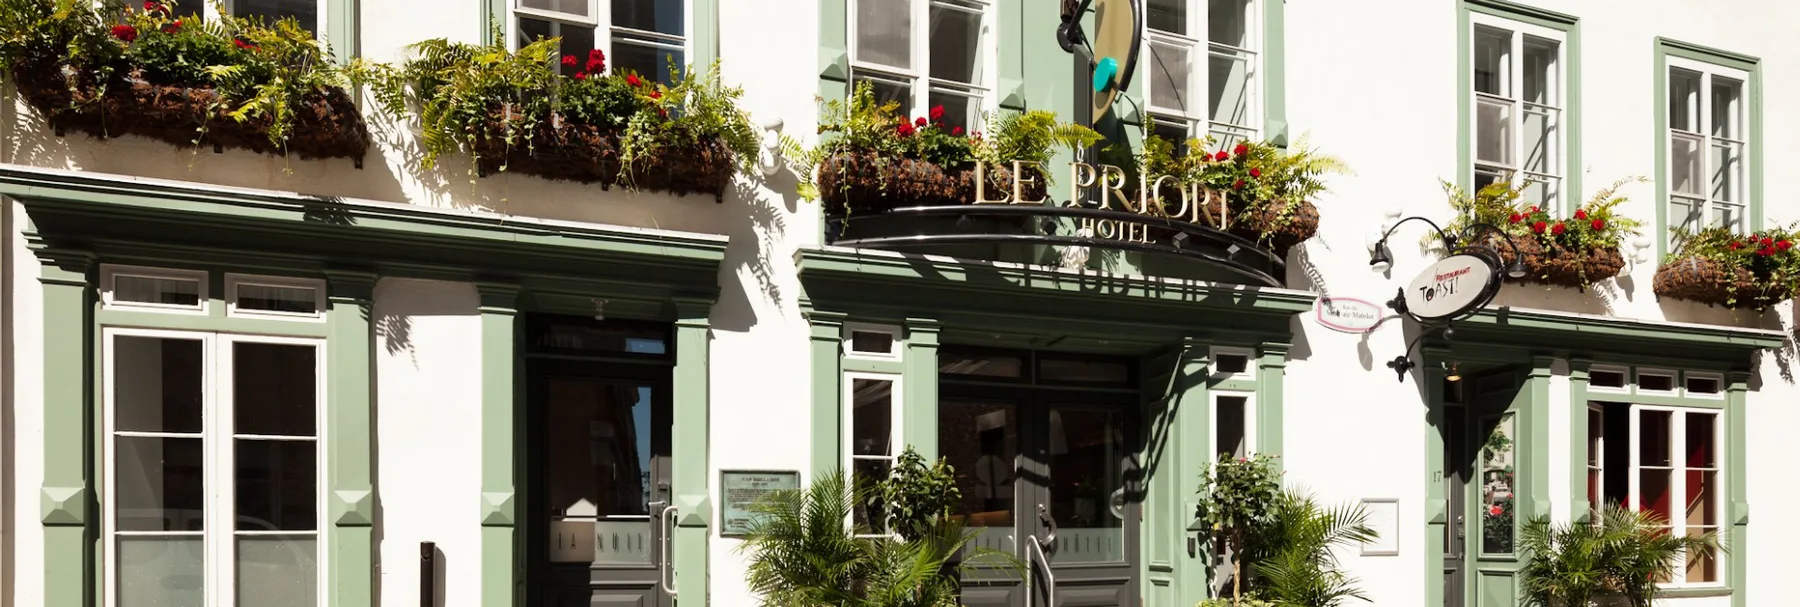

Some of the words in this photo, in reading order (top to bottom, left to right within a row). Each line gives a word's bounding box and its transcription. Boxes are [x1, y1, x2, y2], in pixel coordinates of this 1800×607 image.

[972, 160, 1047, 205] LE
[1067, 162, 1227, 231] PRIORI
[1081, 217, 1156, 244] HOTEL
[1433, 470, 1442, 483] 17
